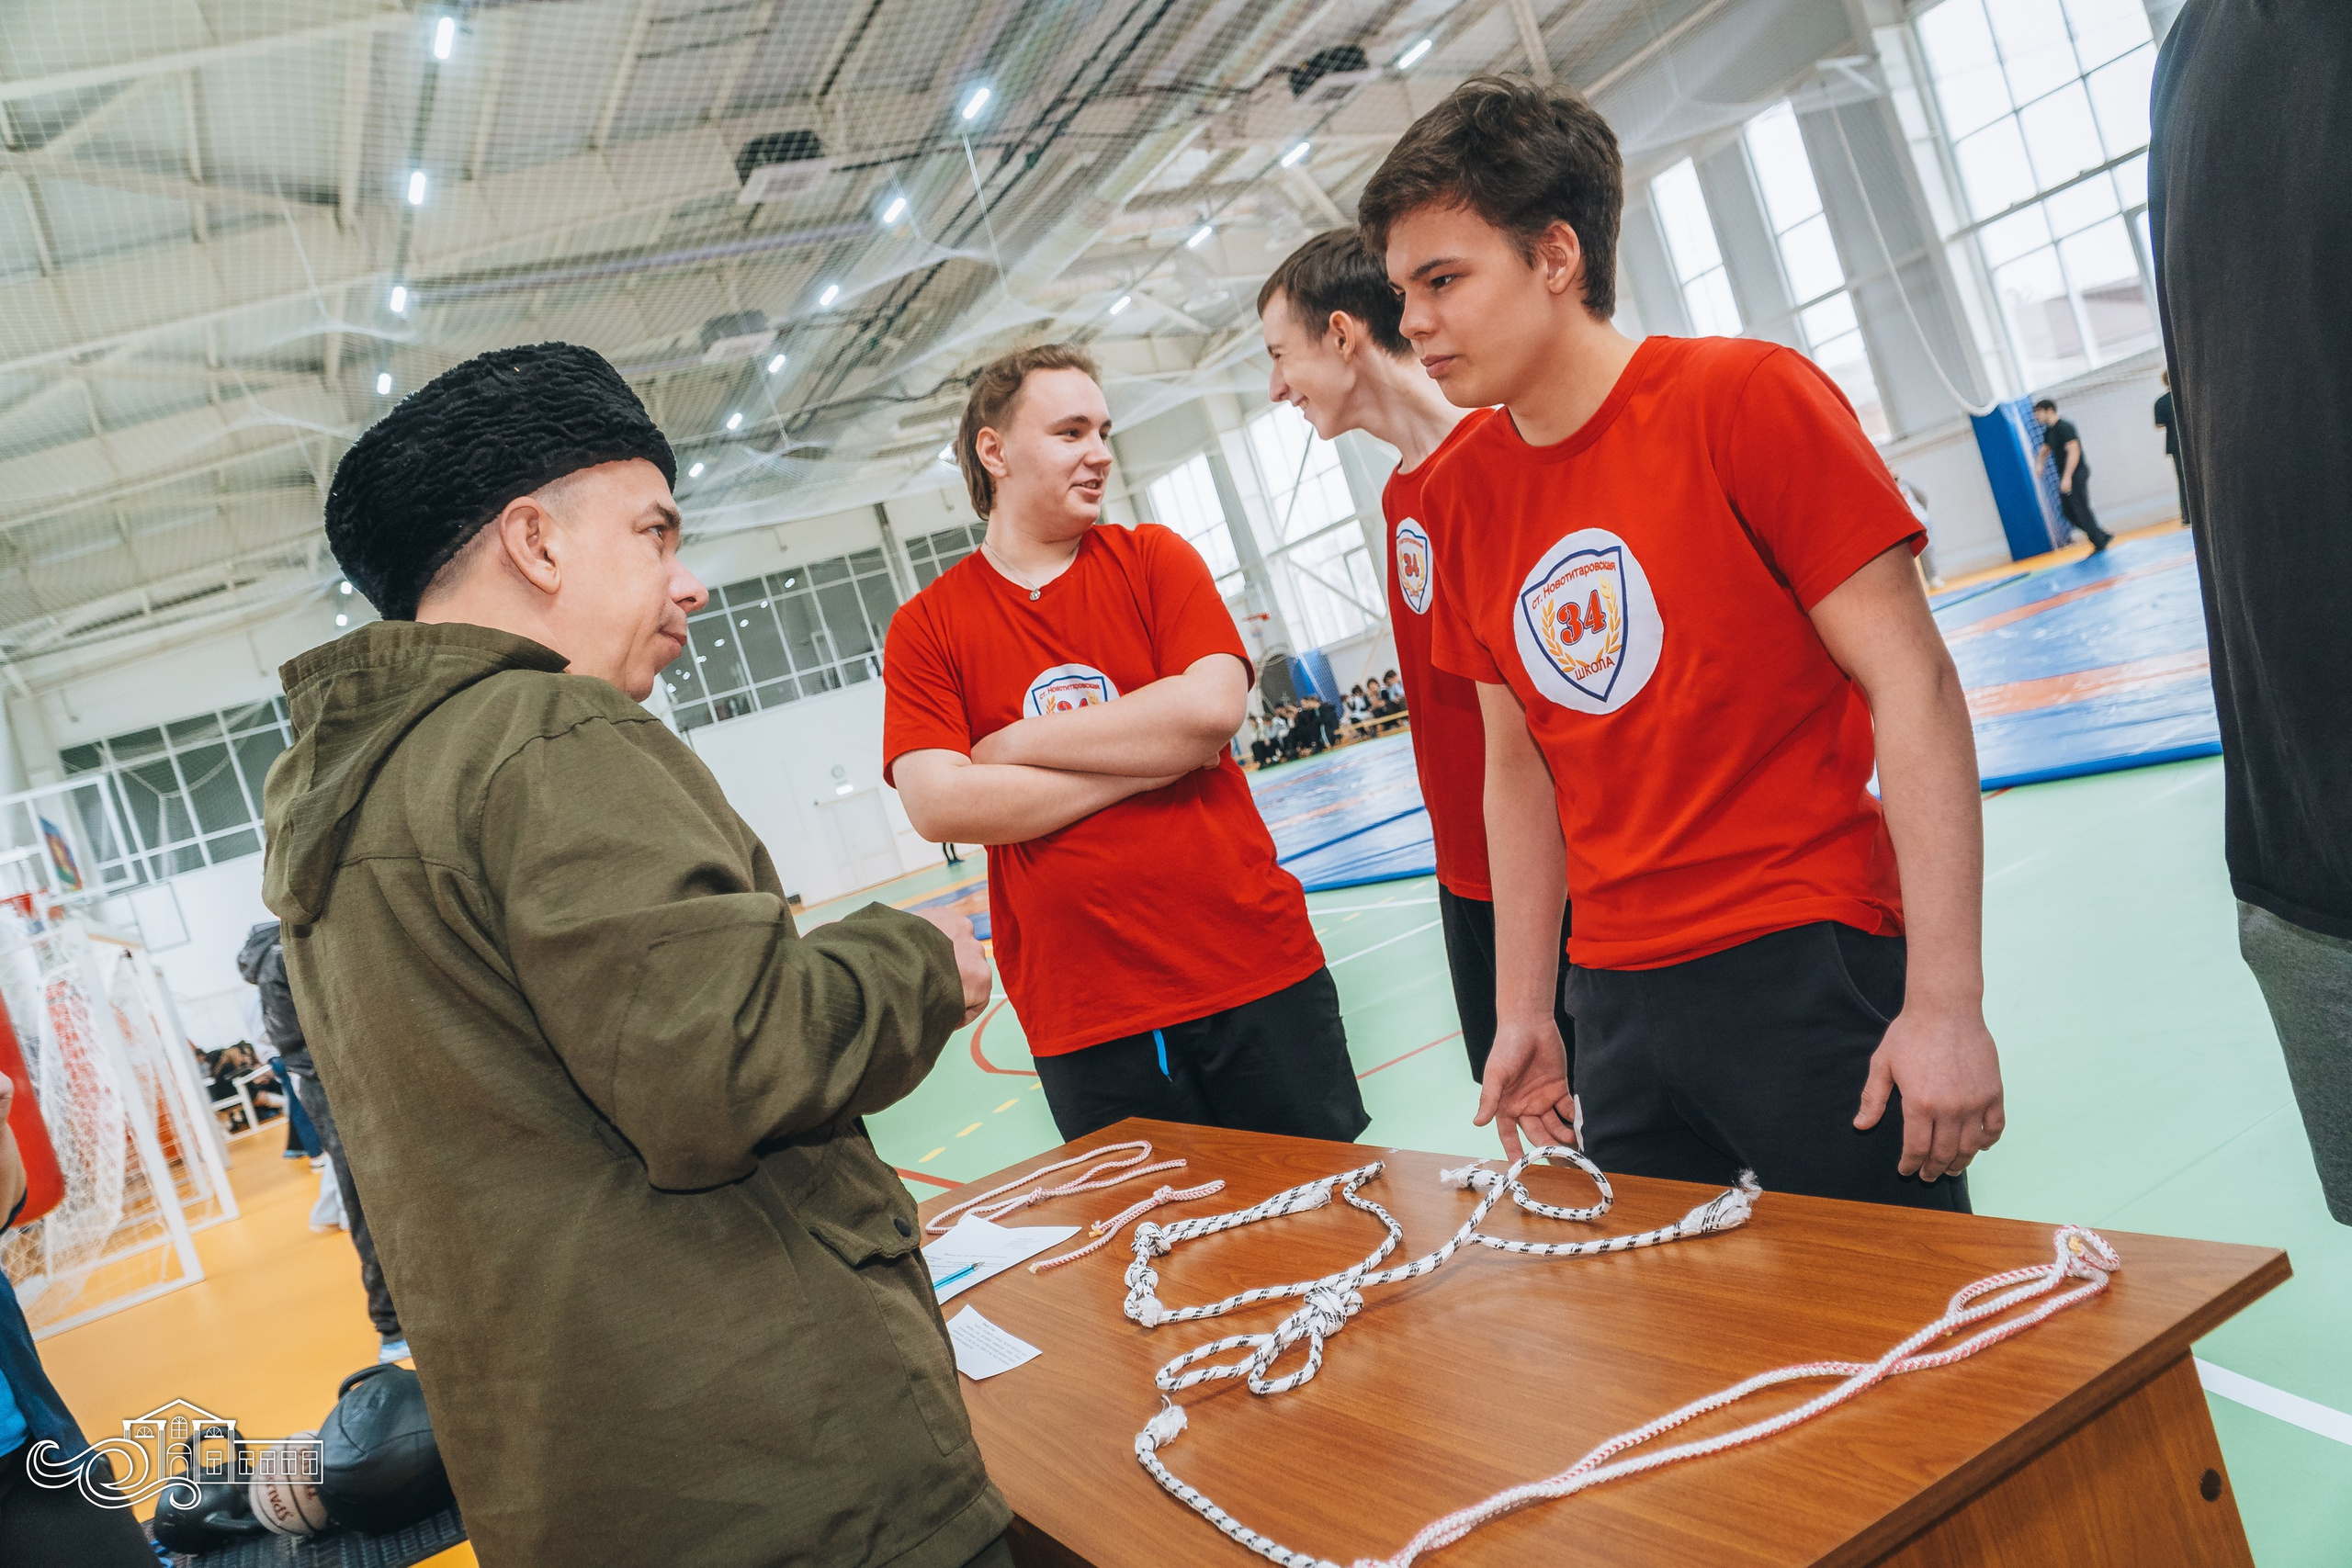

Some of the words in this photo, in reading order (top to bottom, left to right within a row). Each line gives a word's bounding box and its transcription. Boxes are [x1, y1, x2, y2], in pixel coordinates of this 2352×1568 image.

[1404, 553, 1419, 577] 34
[1532, 594, 1543, 610] ст.
[1543, 560, 1616, 599] Новотитаровская
[1556, 589, 1607, 646] 34
[1575, 656, 1615, 681] ШКОЛА
